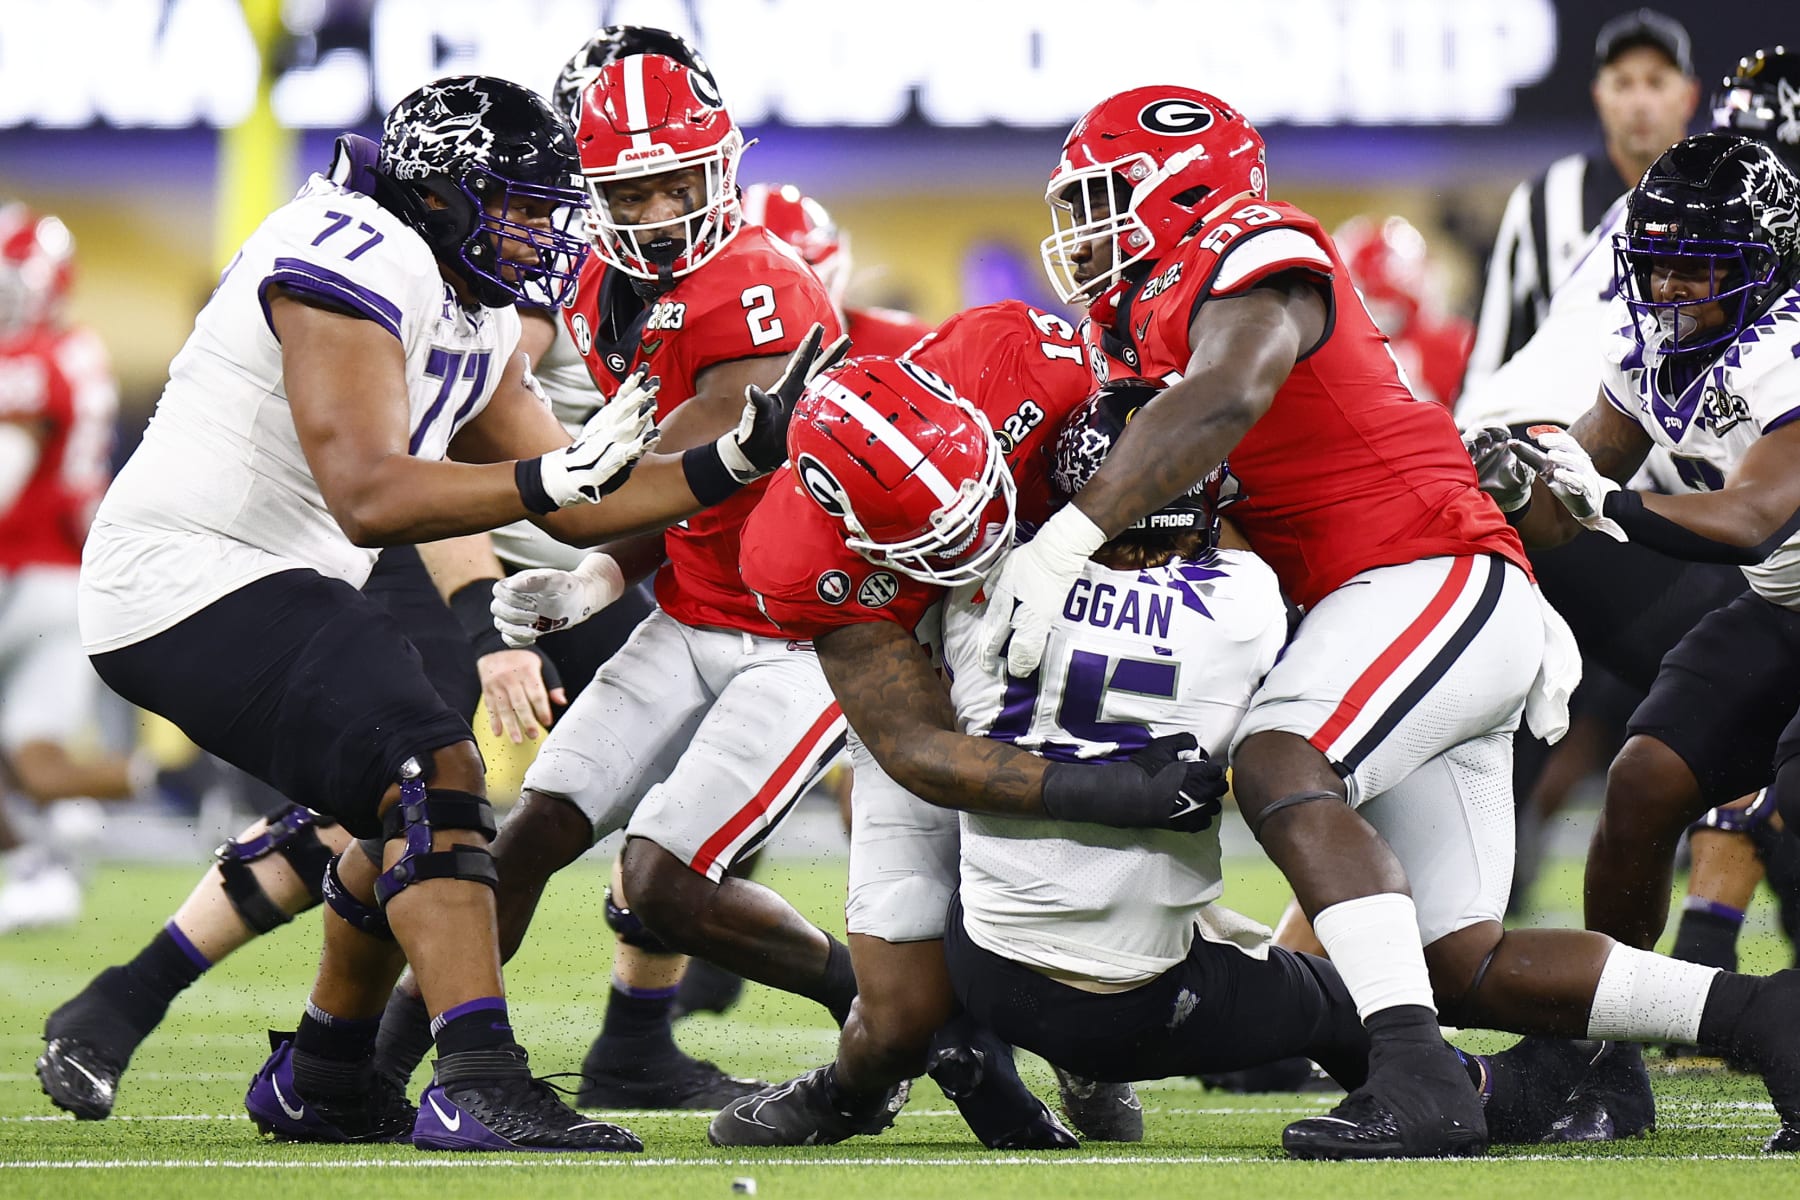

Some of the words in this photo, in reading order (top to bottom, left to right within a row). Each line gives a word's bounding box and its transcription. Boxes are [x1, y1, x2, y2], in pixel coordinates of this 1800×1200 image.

[1138, 98, 1214, 136] G
[625, 148, 665, 161] DAWGS
[311, 211, 385, 261] 77
[741, 285, 784, 346] 2
[1027, 308, 1084, 366] 13
[607, 353, 626, 372] G
[1122, 347, 1138, 367] G
[408, 344, 495, 457] 77
[1664, 416, 1683, 430] TCU
[1151, 513, 1195, 528] FROGS
[859, 573, 897, 607] SEC
[986, 630, 1182, 766] 15
